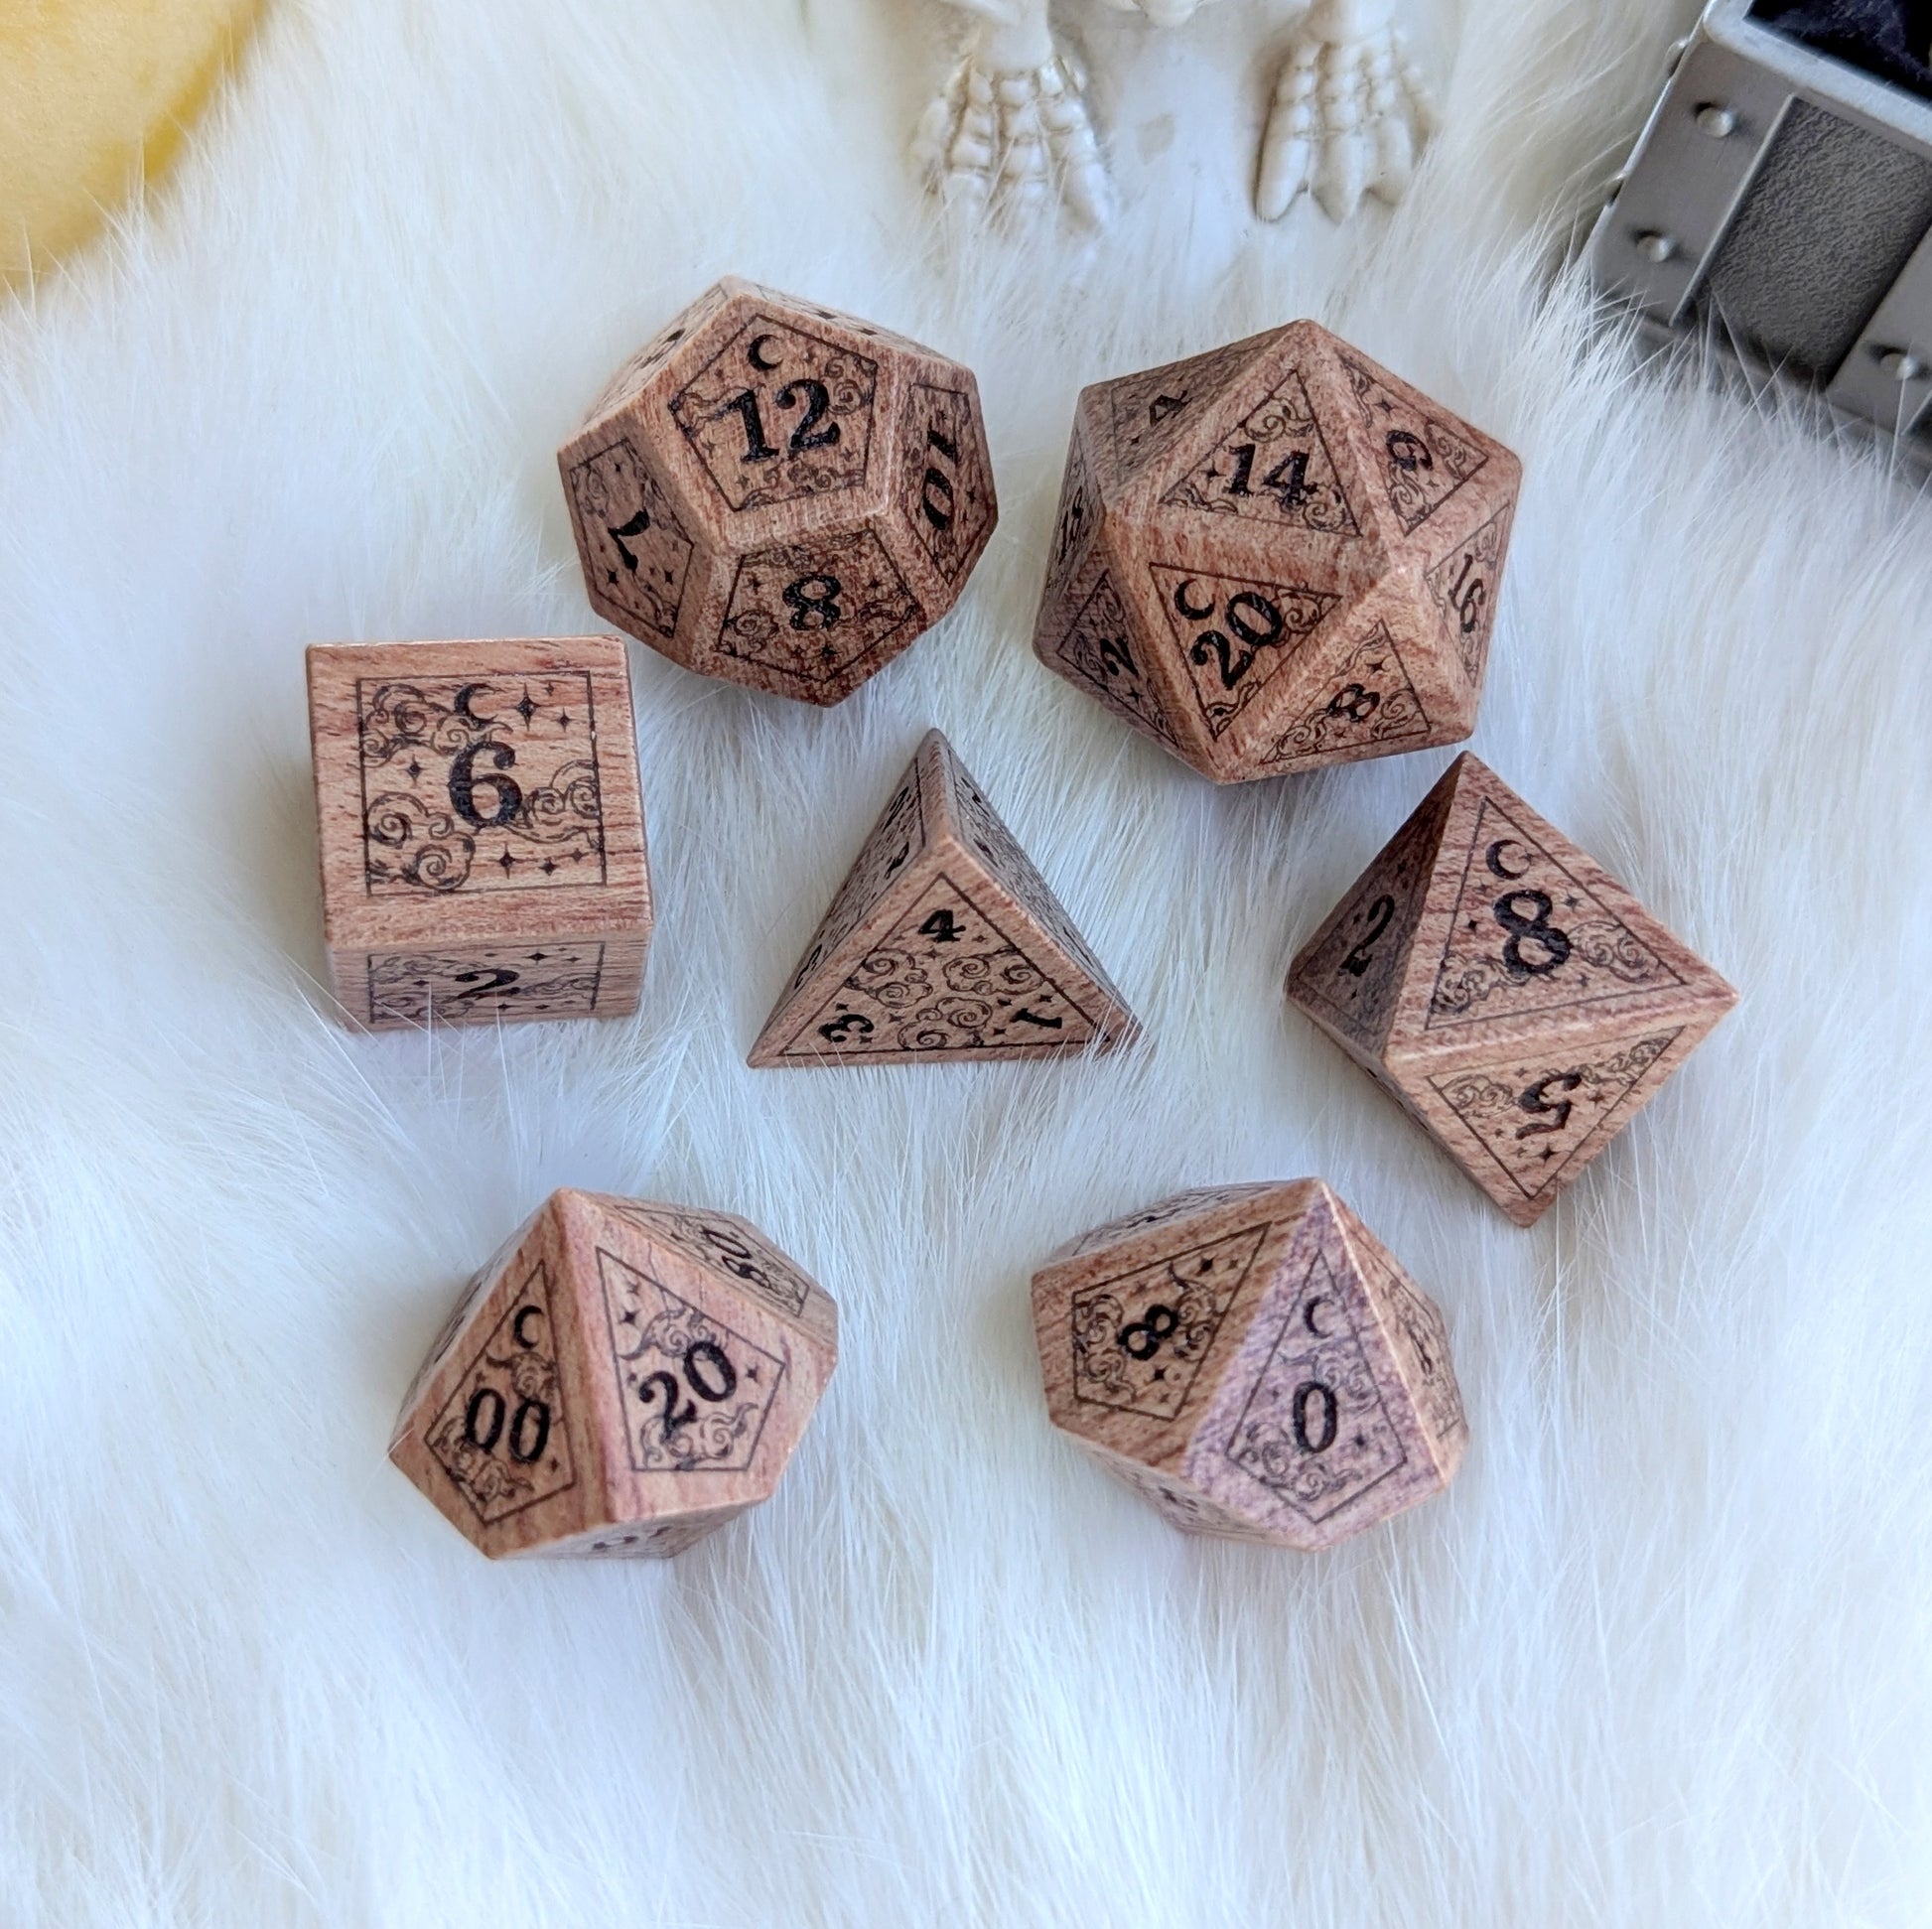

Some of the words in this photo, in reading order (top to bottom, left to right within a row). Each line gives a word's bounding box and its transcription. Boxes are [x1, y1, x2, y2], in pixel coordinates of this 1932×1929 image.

[726, 378, 841, 463] 12
[924, 429, 957, 530] 10
[1226, 444, 1320, 507] 14
[607, 509, 651, 572] 7
[782, 574, 842, 631] 8
[1449, 553, 1485, 635] 16
[1098, 635, 1139, 677] 2
[1192, 590, 1283, 690] 20
[1326, 683, 1381, 723] 8
[448, 740, 523, 827] 6
[918, 909, 966, 943] 4
[1338, 894, 1396, 977] 2
[1493, 890, 1572, 976] 8
[455, 969, 521, 1000] 2
[1012, 1007, 1063, 1030] 1
[817, 1013, 875, 1043] 3
[1515, 1071, 1584, 1141] 5
[1118, 1304, 1177, 1361] 8
[465, 1387, 551, 1464] 00
[637, 1340, 738, 1444] 20
[1293, 1381, 1337, 1452] 0
